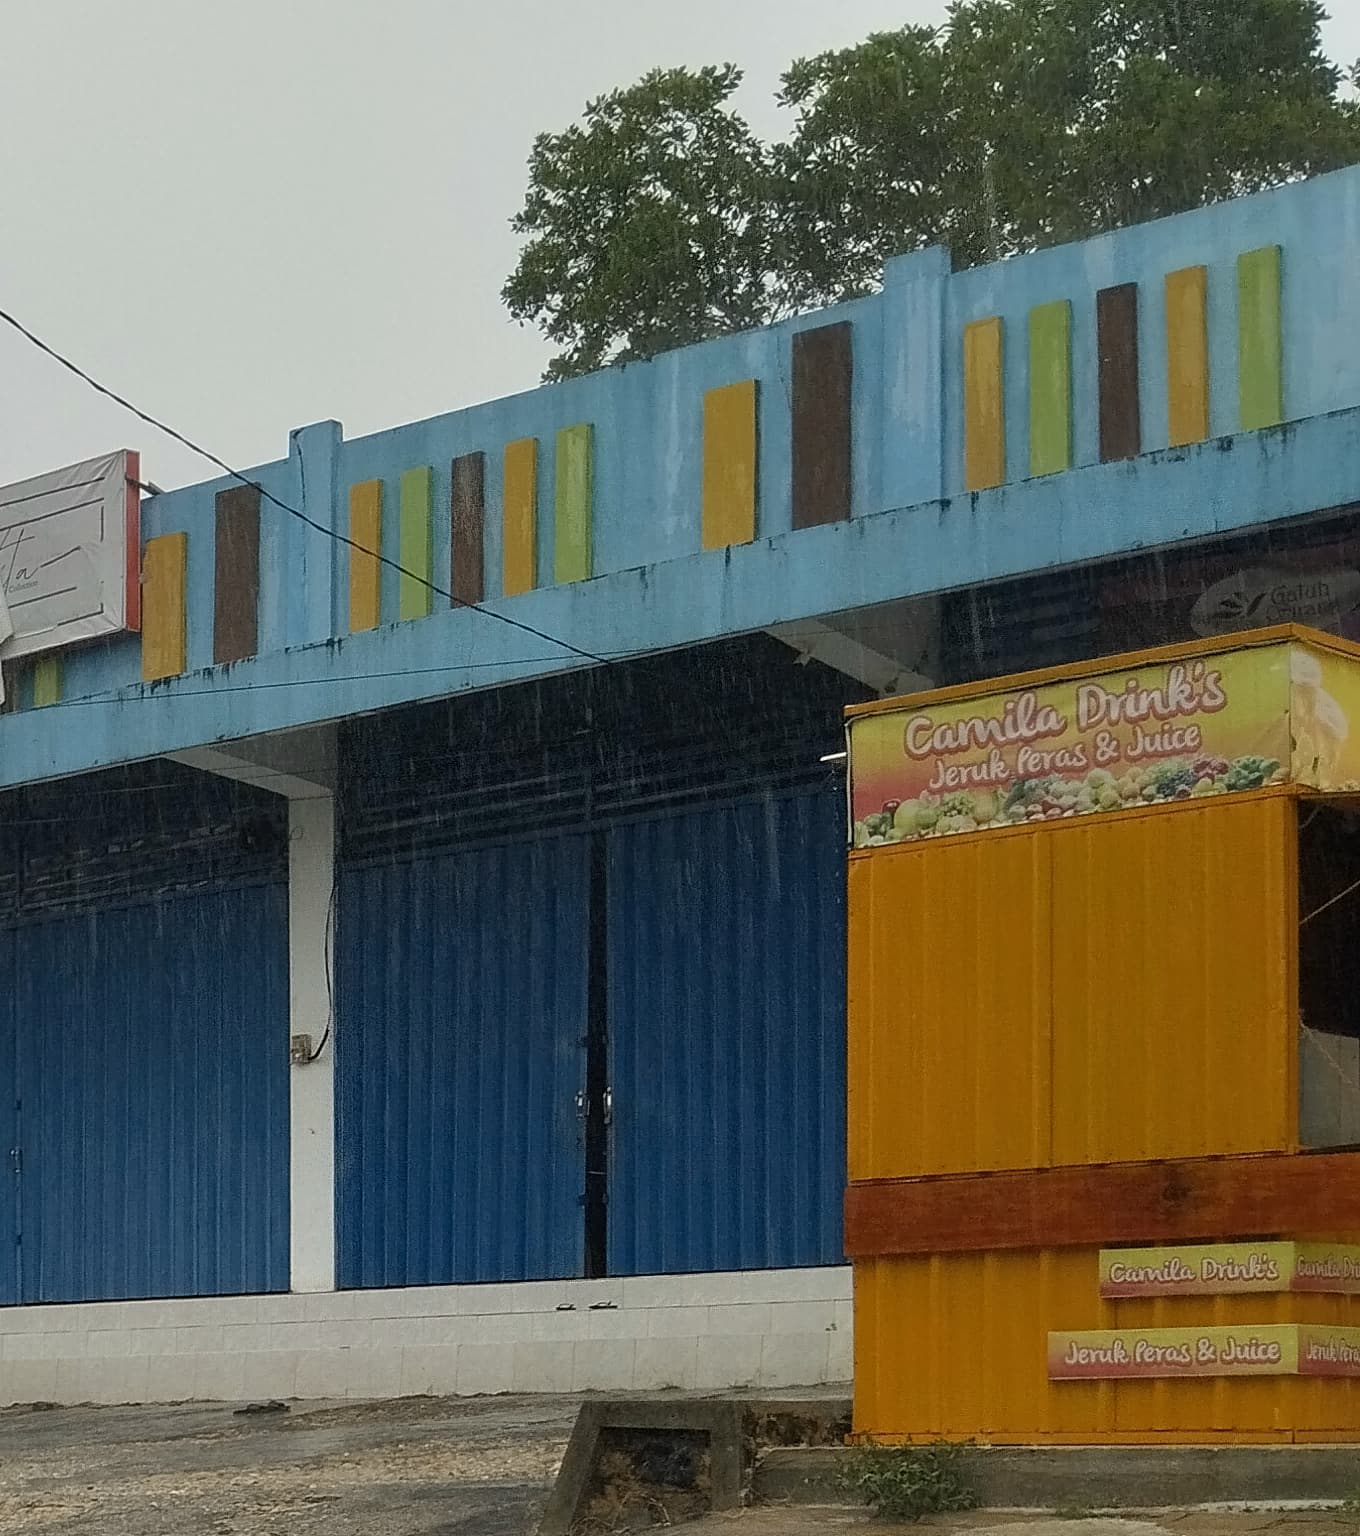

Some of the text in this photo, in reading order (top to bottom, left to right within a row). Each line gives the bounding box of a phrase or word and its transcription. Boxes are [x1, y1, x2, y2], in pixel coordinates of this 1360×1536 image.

[906, 663, 1226, 757] Camila Drink's
[931, 725, 1202, 790] Jeruk Peras & Juice
[1110, 1254, 1280, 1284] Camila Drink's
[1064, 1337, 1281, 1366] Jeruk Peras & Juice
